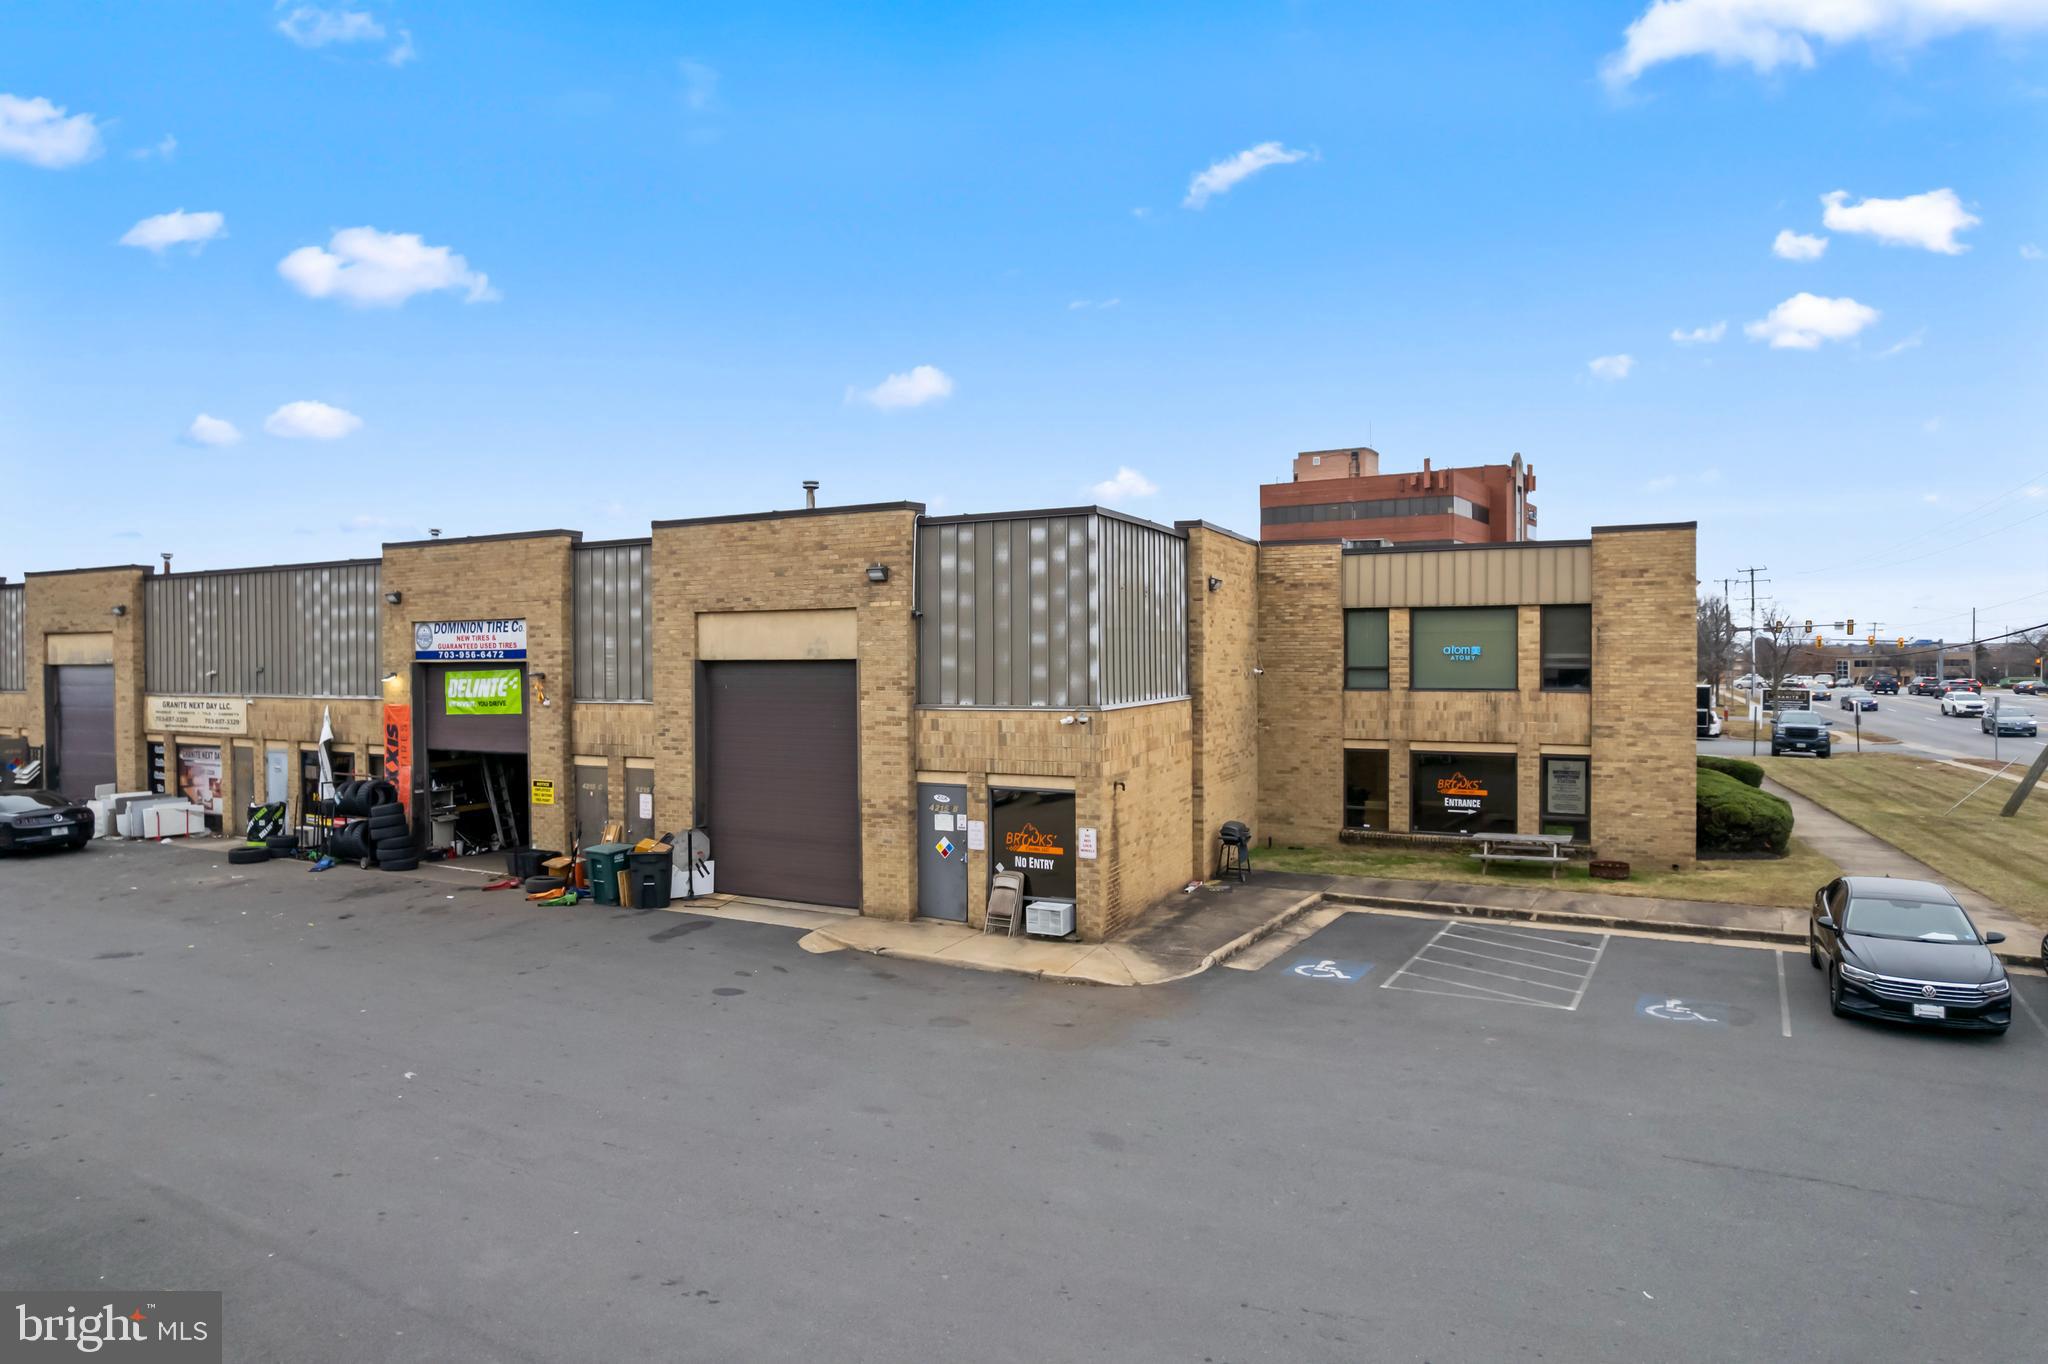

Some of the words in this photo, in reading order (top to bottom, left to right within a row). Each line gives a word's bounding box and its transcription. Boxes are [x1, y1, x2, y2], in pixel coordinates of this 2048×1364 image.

[434, 622, 484, 634] DOMINION
[486, 621, 509, 633] TIRE
[438, 650, 504, 659] 703-956-6472
[448, 677, 509, 698] DELINTE
[162, 701, 187, 709] GRANITE
[206, 702, 217, 710] DAY
[1444, 797, 1481, 808] ENTRANCE
[1028, 856, 1054, 870] ENTRY
